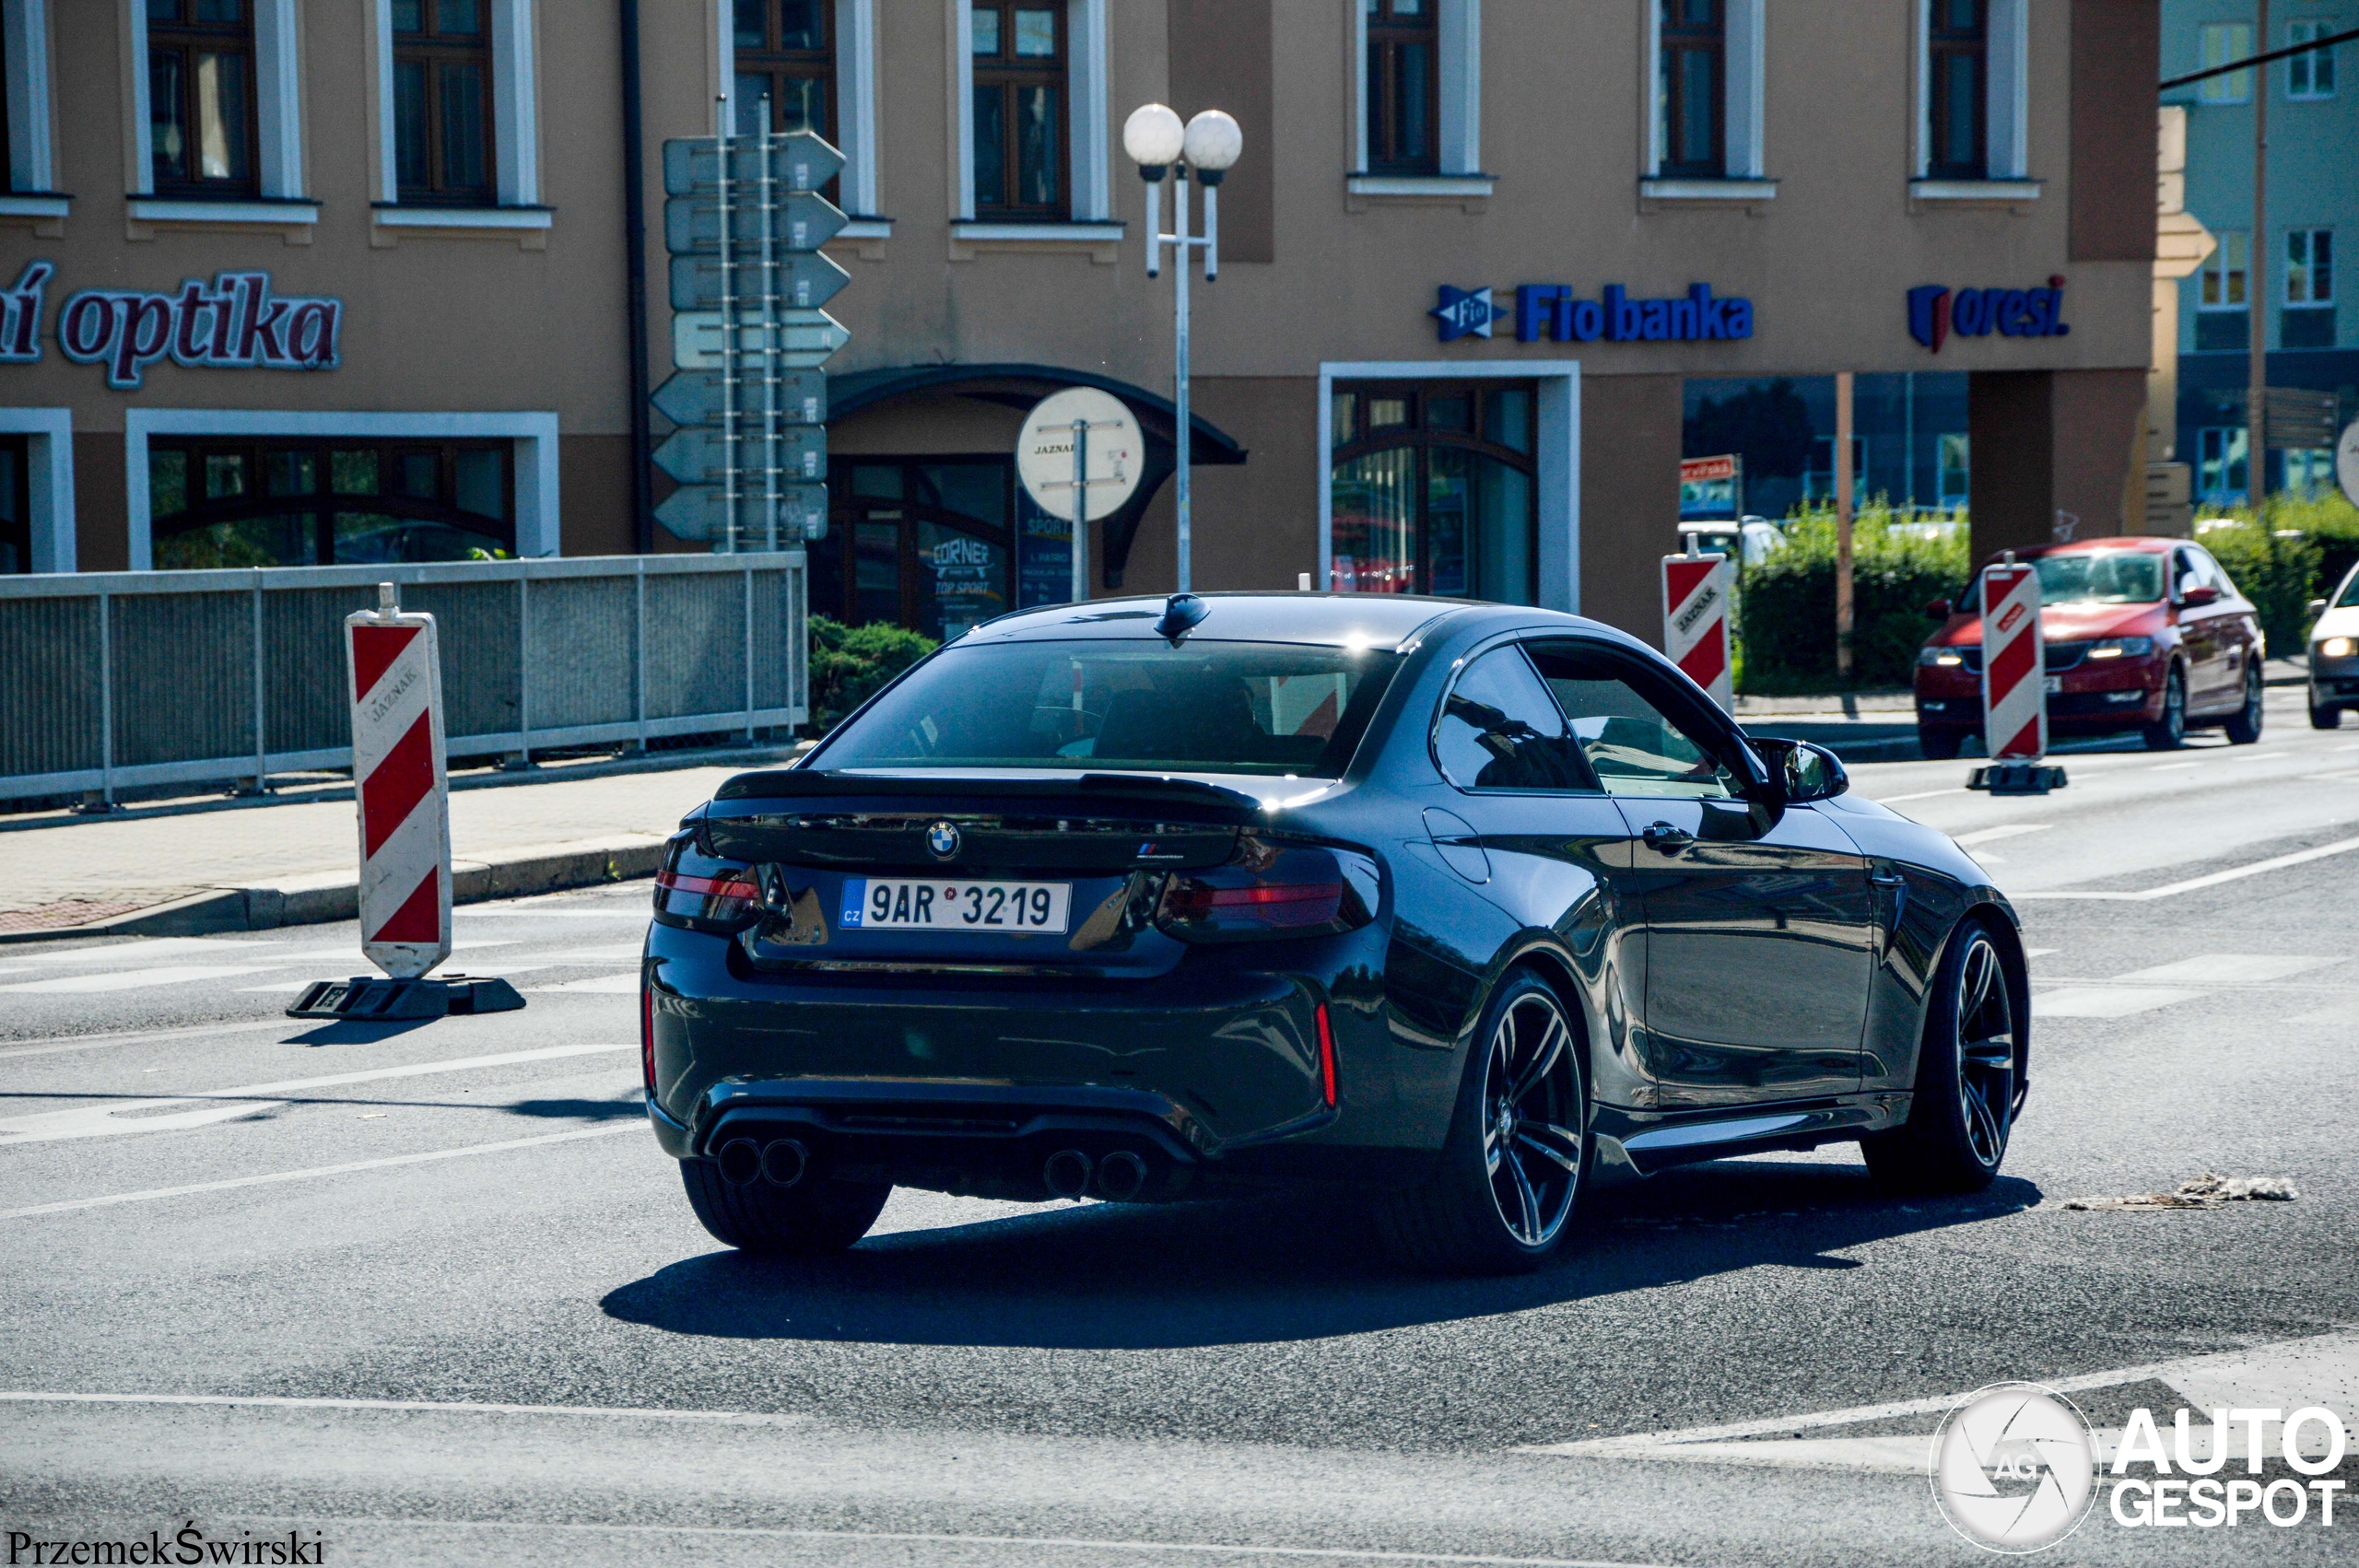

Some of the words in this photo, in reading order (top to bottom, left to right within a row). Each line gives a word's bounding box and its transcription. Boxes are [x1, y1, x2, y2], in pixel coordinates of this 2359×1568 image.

[0, 268, 46, 354] í
[65, 276, 337, 380] optika
[1458, 298, 1485, 329] Fio
[1517, 284, 1603, 343] Fio
[1603, 283, 1754, 341] banka
[933, 538, 990, 564] CORNER
[935, 581, 956, 594] TOP
[957, 581, 990, 595] SPORT
[1679, 587, 1717, 632] JAZNAK
[371, 668, 420, 724] JAZNAK
[844, 909, 860, 922] CZ
[871, 884, 934, 924] 9AR
[962, 886, 1051, 926] 3219
